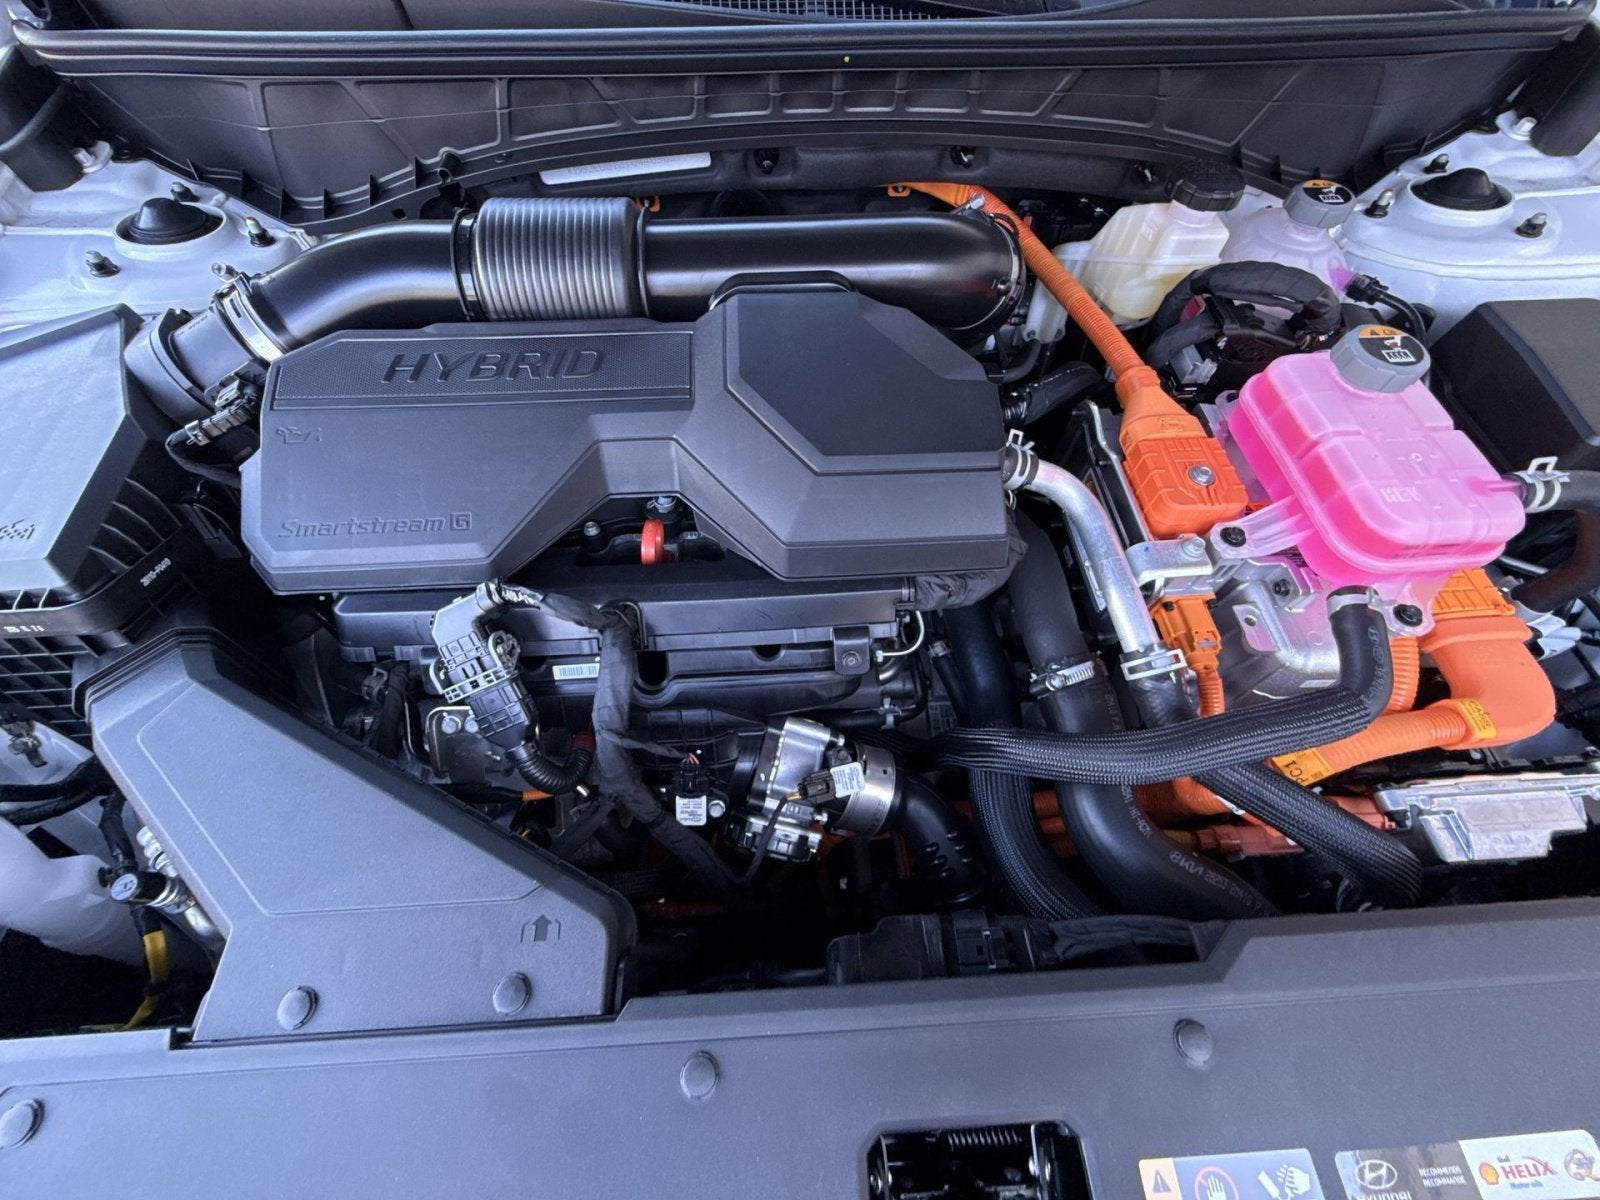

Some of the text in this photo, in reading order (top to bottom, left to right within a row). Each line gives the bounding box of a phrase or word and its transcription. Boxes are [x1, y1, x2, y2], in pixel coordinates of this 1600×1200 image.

[381, 350, 604, 384] HYBRID
[278, 517, 445, 539] Smartstream
[1501, 1161, 1555, 1179] HELIX
